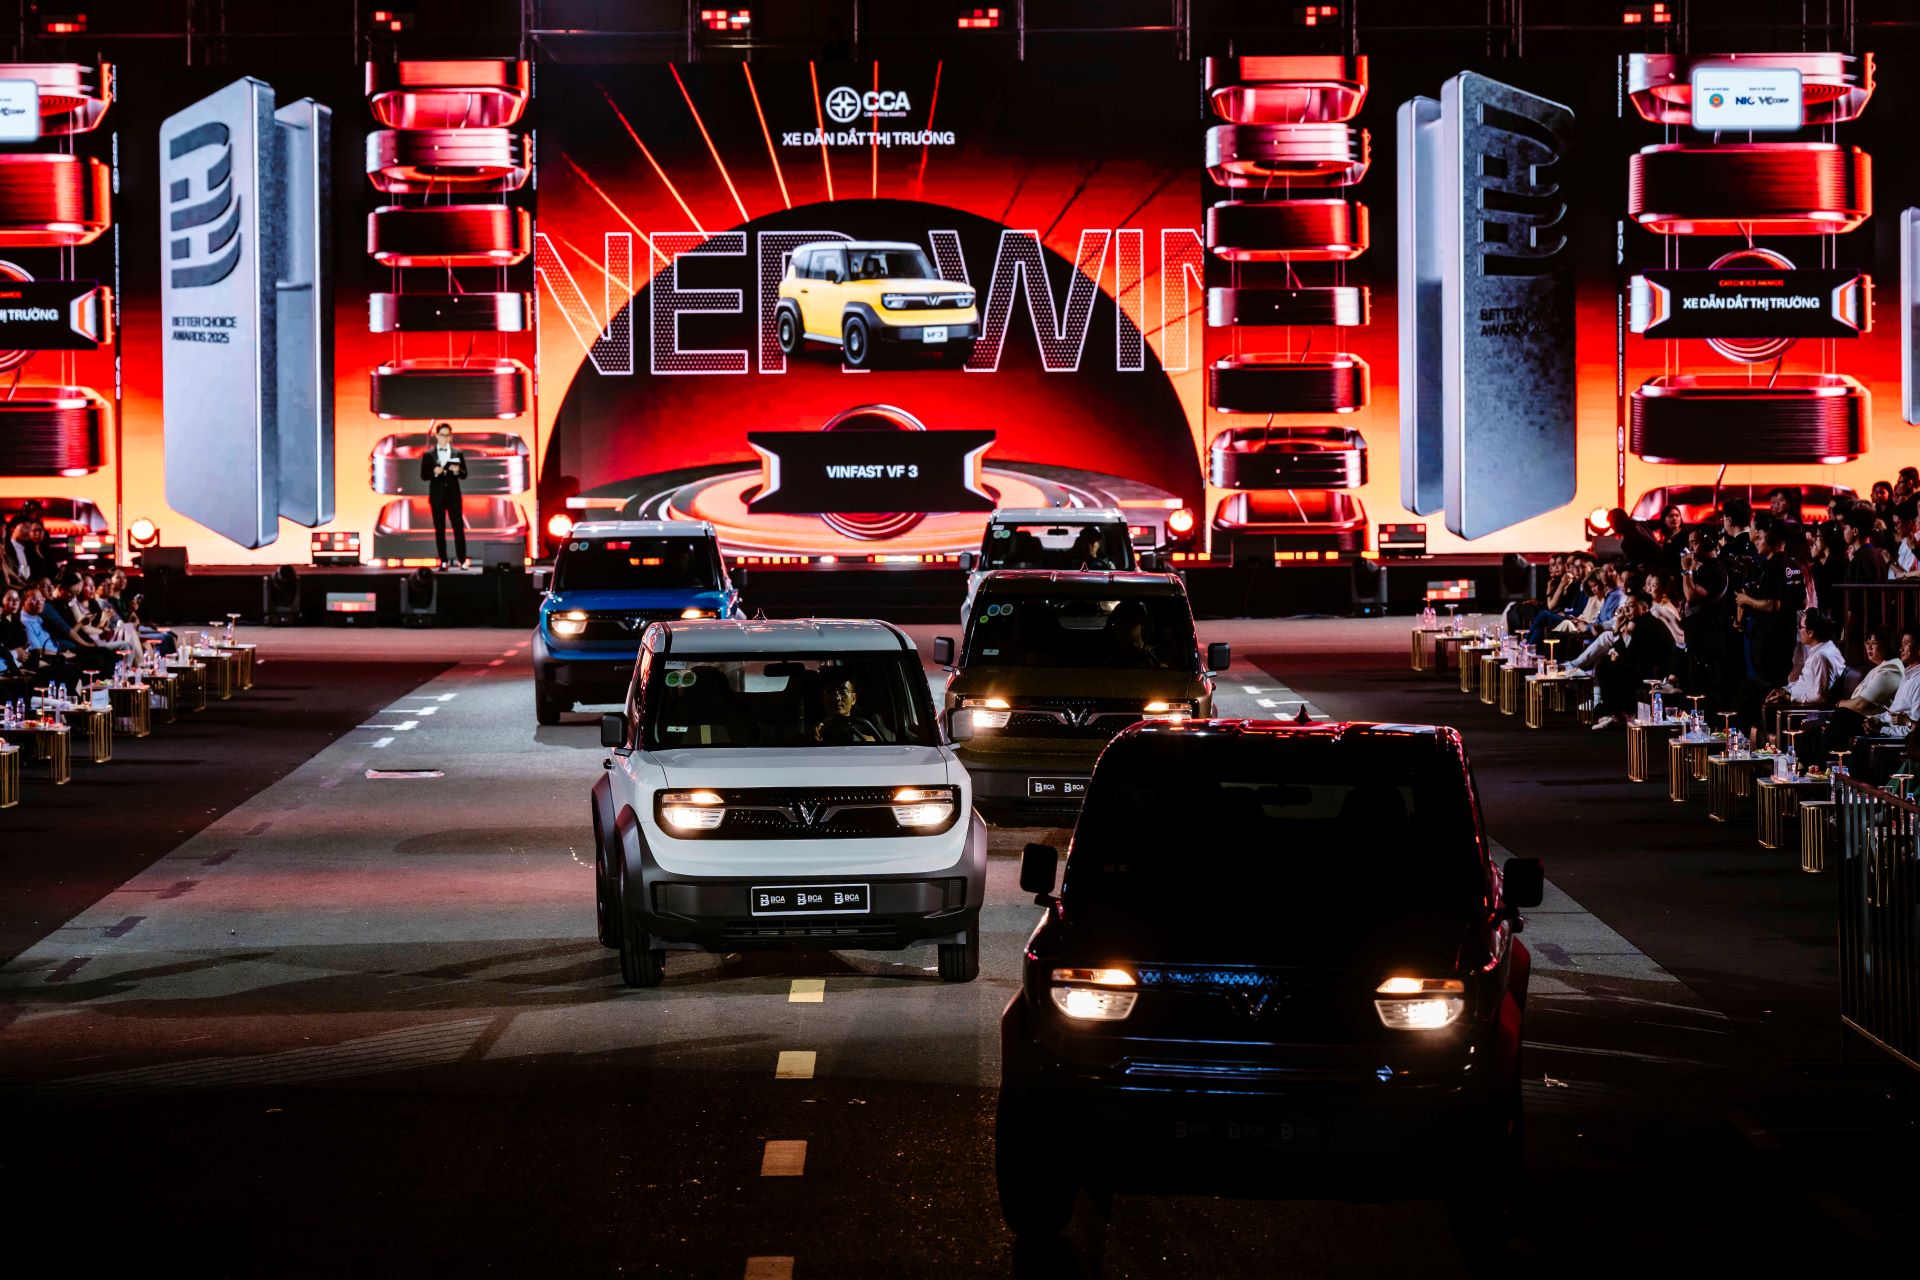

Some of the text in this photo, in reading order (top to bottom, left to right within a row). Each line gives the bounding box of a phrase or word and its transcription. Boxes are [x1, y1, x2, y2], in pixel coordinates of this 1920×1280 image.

[863, 91, 911, 111] CCA
[1736, 96, 1756, 105] NIC
[782, 132, 801, 146] XE
[866, 132, 891, 148] THỊ
[892, 130, 956, 146] TRƯỜNG
[1683, 297, 1699, 309] XE
[1750, 297, 1769, 311] THỊ
[1770, 296, 1820, 309] TRƯỜNG
[172, 316, 236, 328] BETTER CHOICE
[172, 331, 230, 344] AWARDS 2025
[826, 465, 918, 478] VINFAST VF 3
